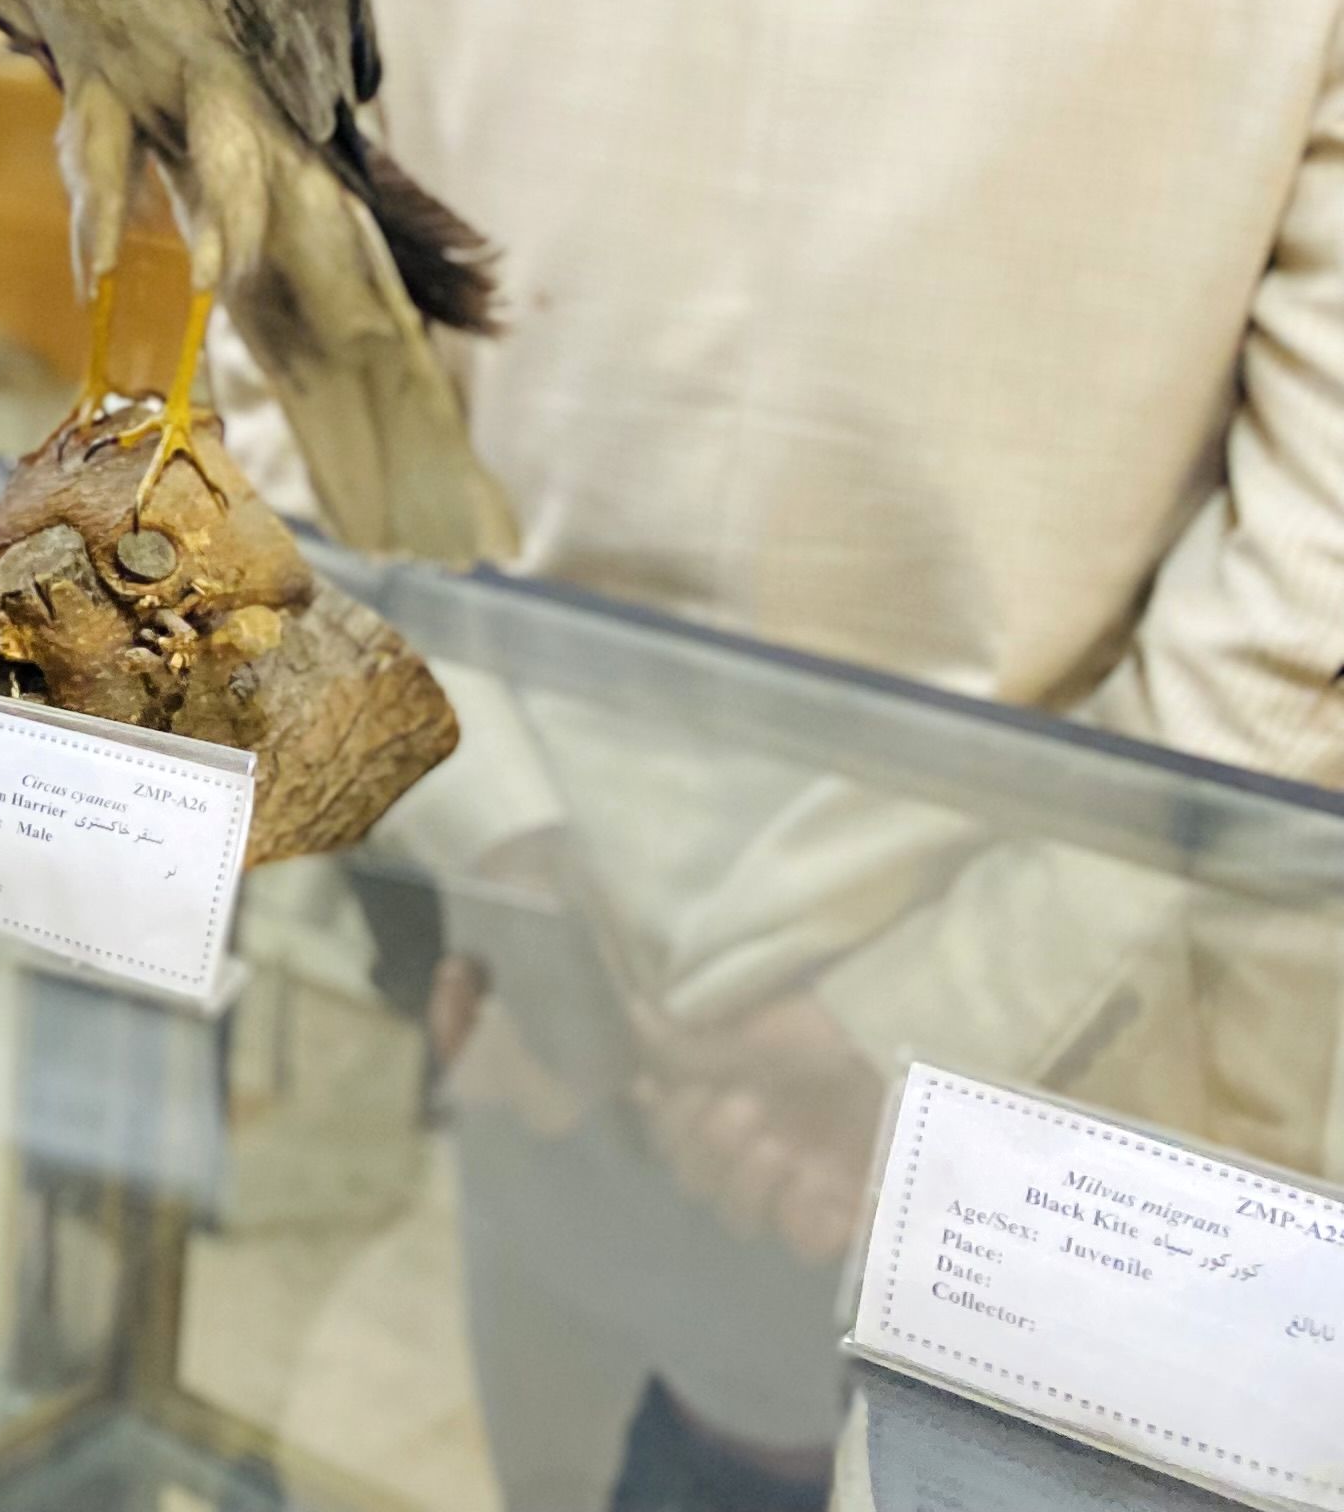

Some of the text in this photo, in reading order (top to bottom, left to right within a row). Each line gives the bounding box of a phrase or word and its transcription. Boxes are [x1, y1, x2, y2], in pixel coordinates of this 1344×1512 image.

[11, 792, 68, 818] Harrier
[21, 774, 128, 813] Circus cyaneus
[133, 782, 208, 813] ZMP-A26
[16, 821, 53, 842] Male
[1025, 1186, 1140, 1239] Black Kite
[1062, 1170, 1231, 1239] Milvus migrans
[941, 1228, 1004, 1265] Place:
[946, 1199, 1154, 1281] Age/Sex: Juvenile
[936, 1253, 992, 1288] Date:
[931, 1280, 1037, 1332] Collector:
